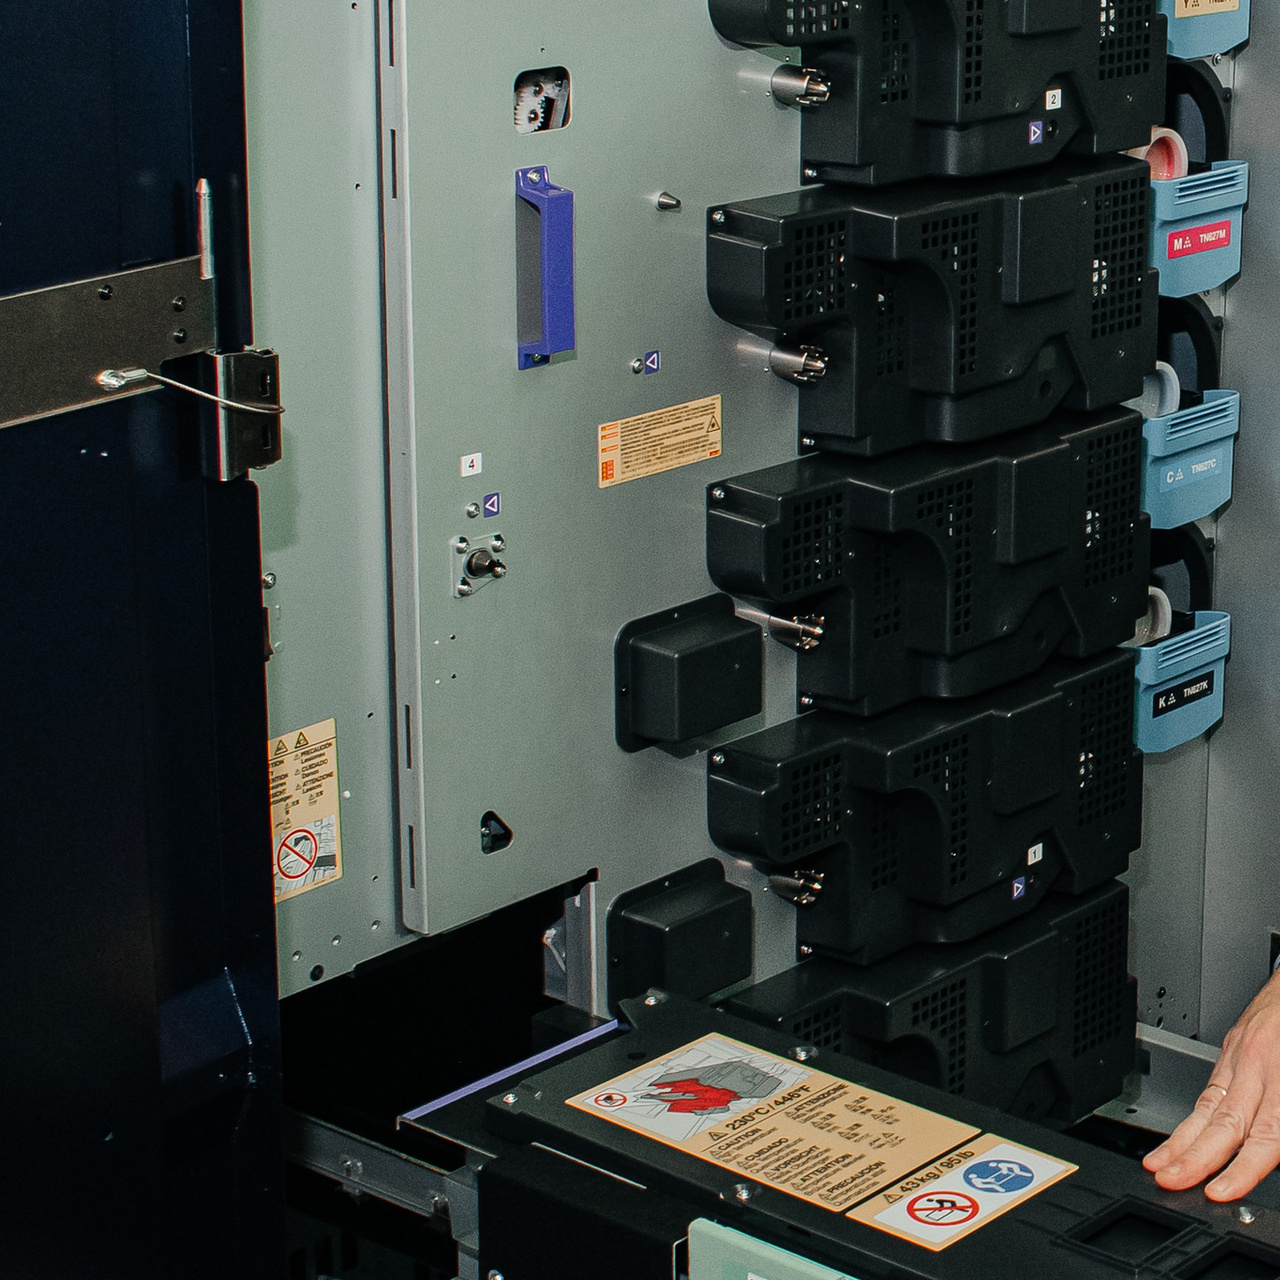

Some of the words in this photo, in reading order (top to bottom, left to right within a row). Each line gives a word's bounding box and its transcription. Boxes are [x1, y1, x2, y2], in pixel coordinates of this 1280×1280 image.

[1051, 94, 1057, 105] 2
[1174, 237, 1182, 251] M
[1200, 229, 1226, 243] TN627M
[468, 458, 475, 469] 4
[1166, 471, 1174, 483] C
[1159, 696, 1167, 710] K
[726, 1106, 771, 1131] 230°C
[774, 1084, 812, 1106] 446°F
[794, 1083, 850, 1113] ATTENZIONE
[718, 1127, 763, 1151] CAUTION
[744, 1138, 790, 1162] CUIDADO
[770, 1144, 820, 1172] VORSICHT
[800, 1153, 853, 1183] ATTENTION
[900, 1180, 921, 1193] 43
[914, 1171, 941, 1184] kg
[940, 1156, 962, 1169] 95
[956, 1150, 975, 1160] lb
